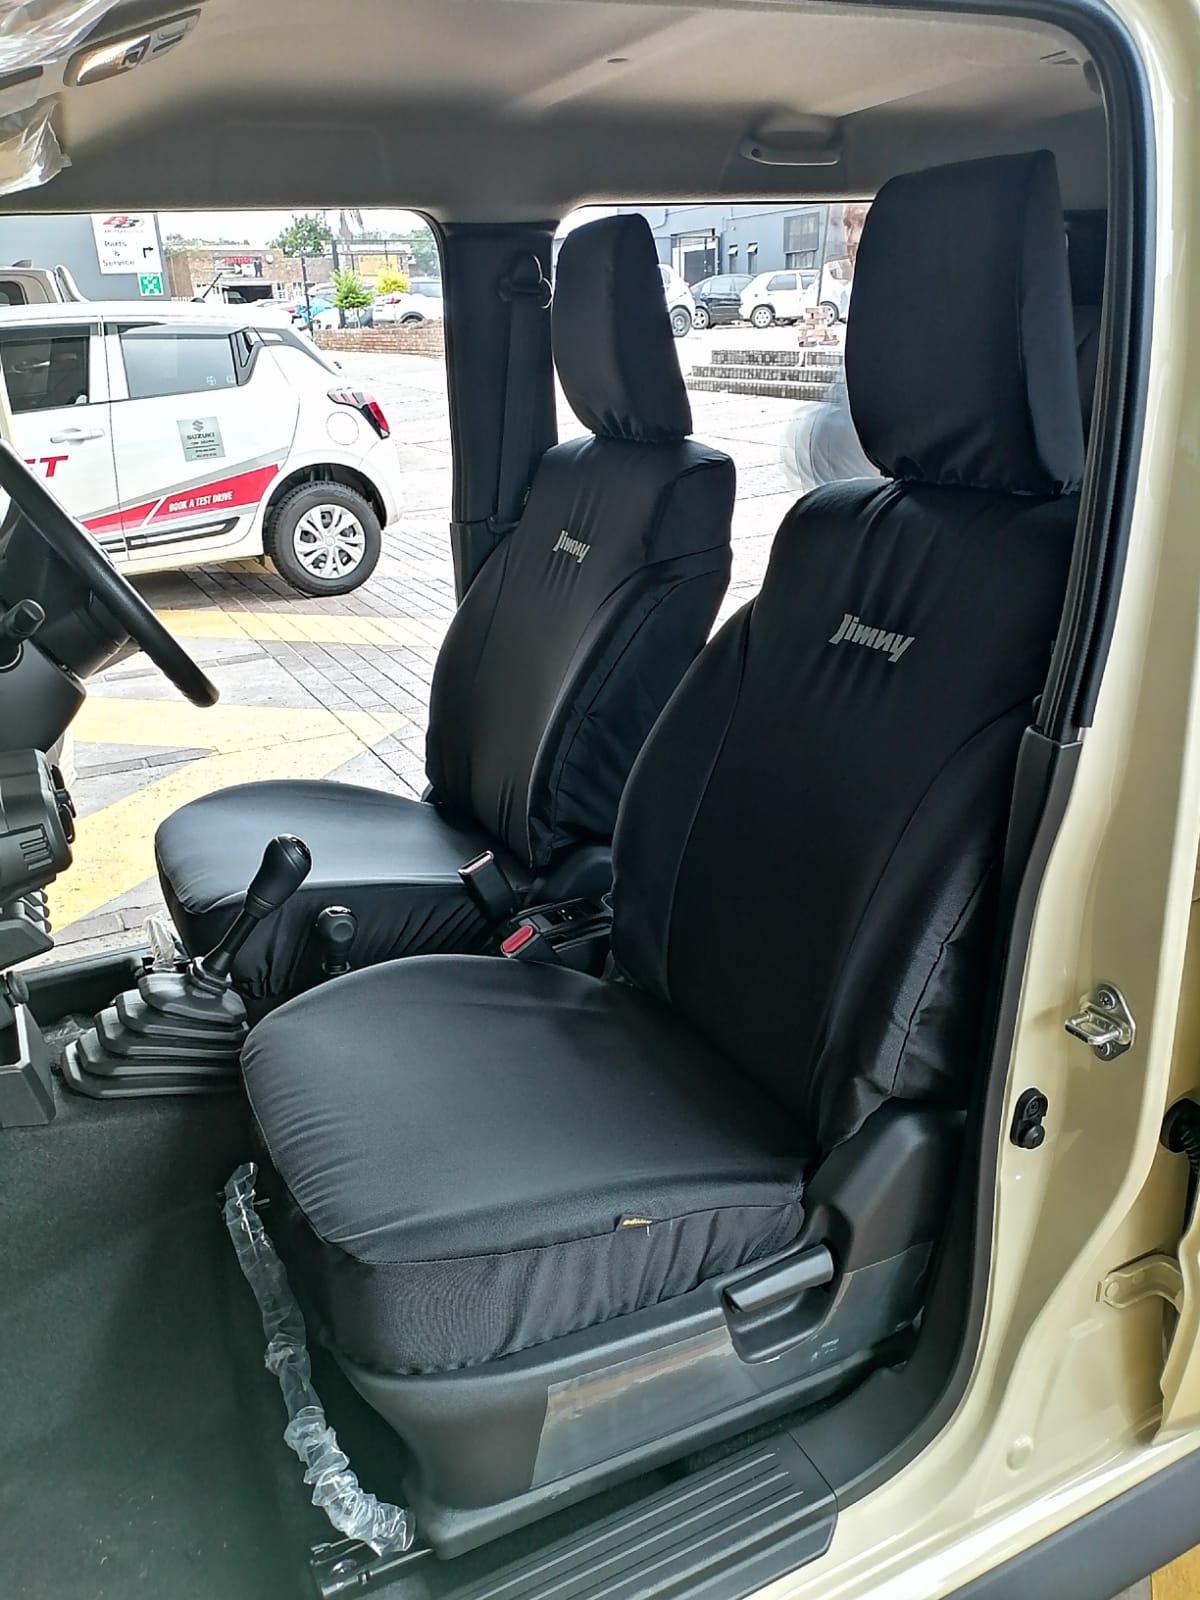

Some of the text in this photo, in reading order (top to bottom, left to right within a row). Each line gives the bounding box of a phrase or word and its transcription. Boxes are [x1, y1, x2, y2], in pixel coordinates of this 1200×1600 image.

[186, 431, 215, 440] SUZUKI
[168, 490, 233, 513] BOOK A TEST DRIVE
[552, 529, 591, 564] Jimny
[828, 613, 916, 663] Jimny
